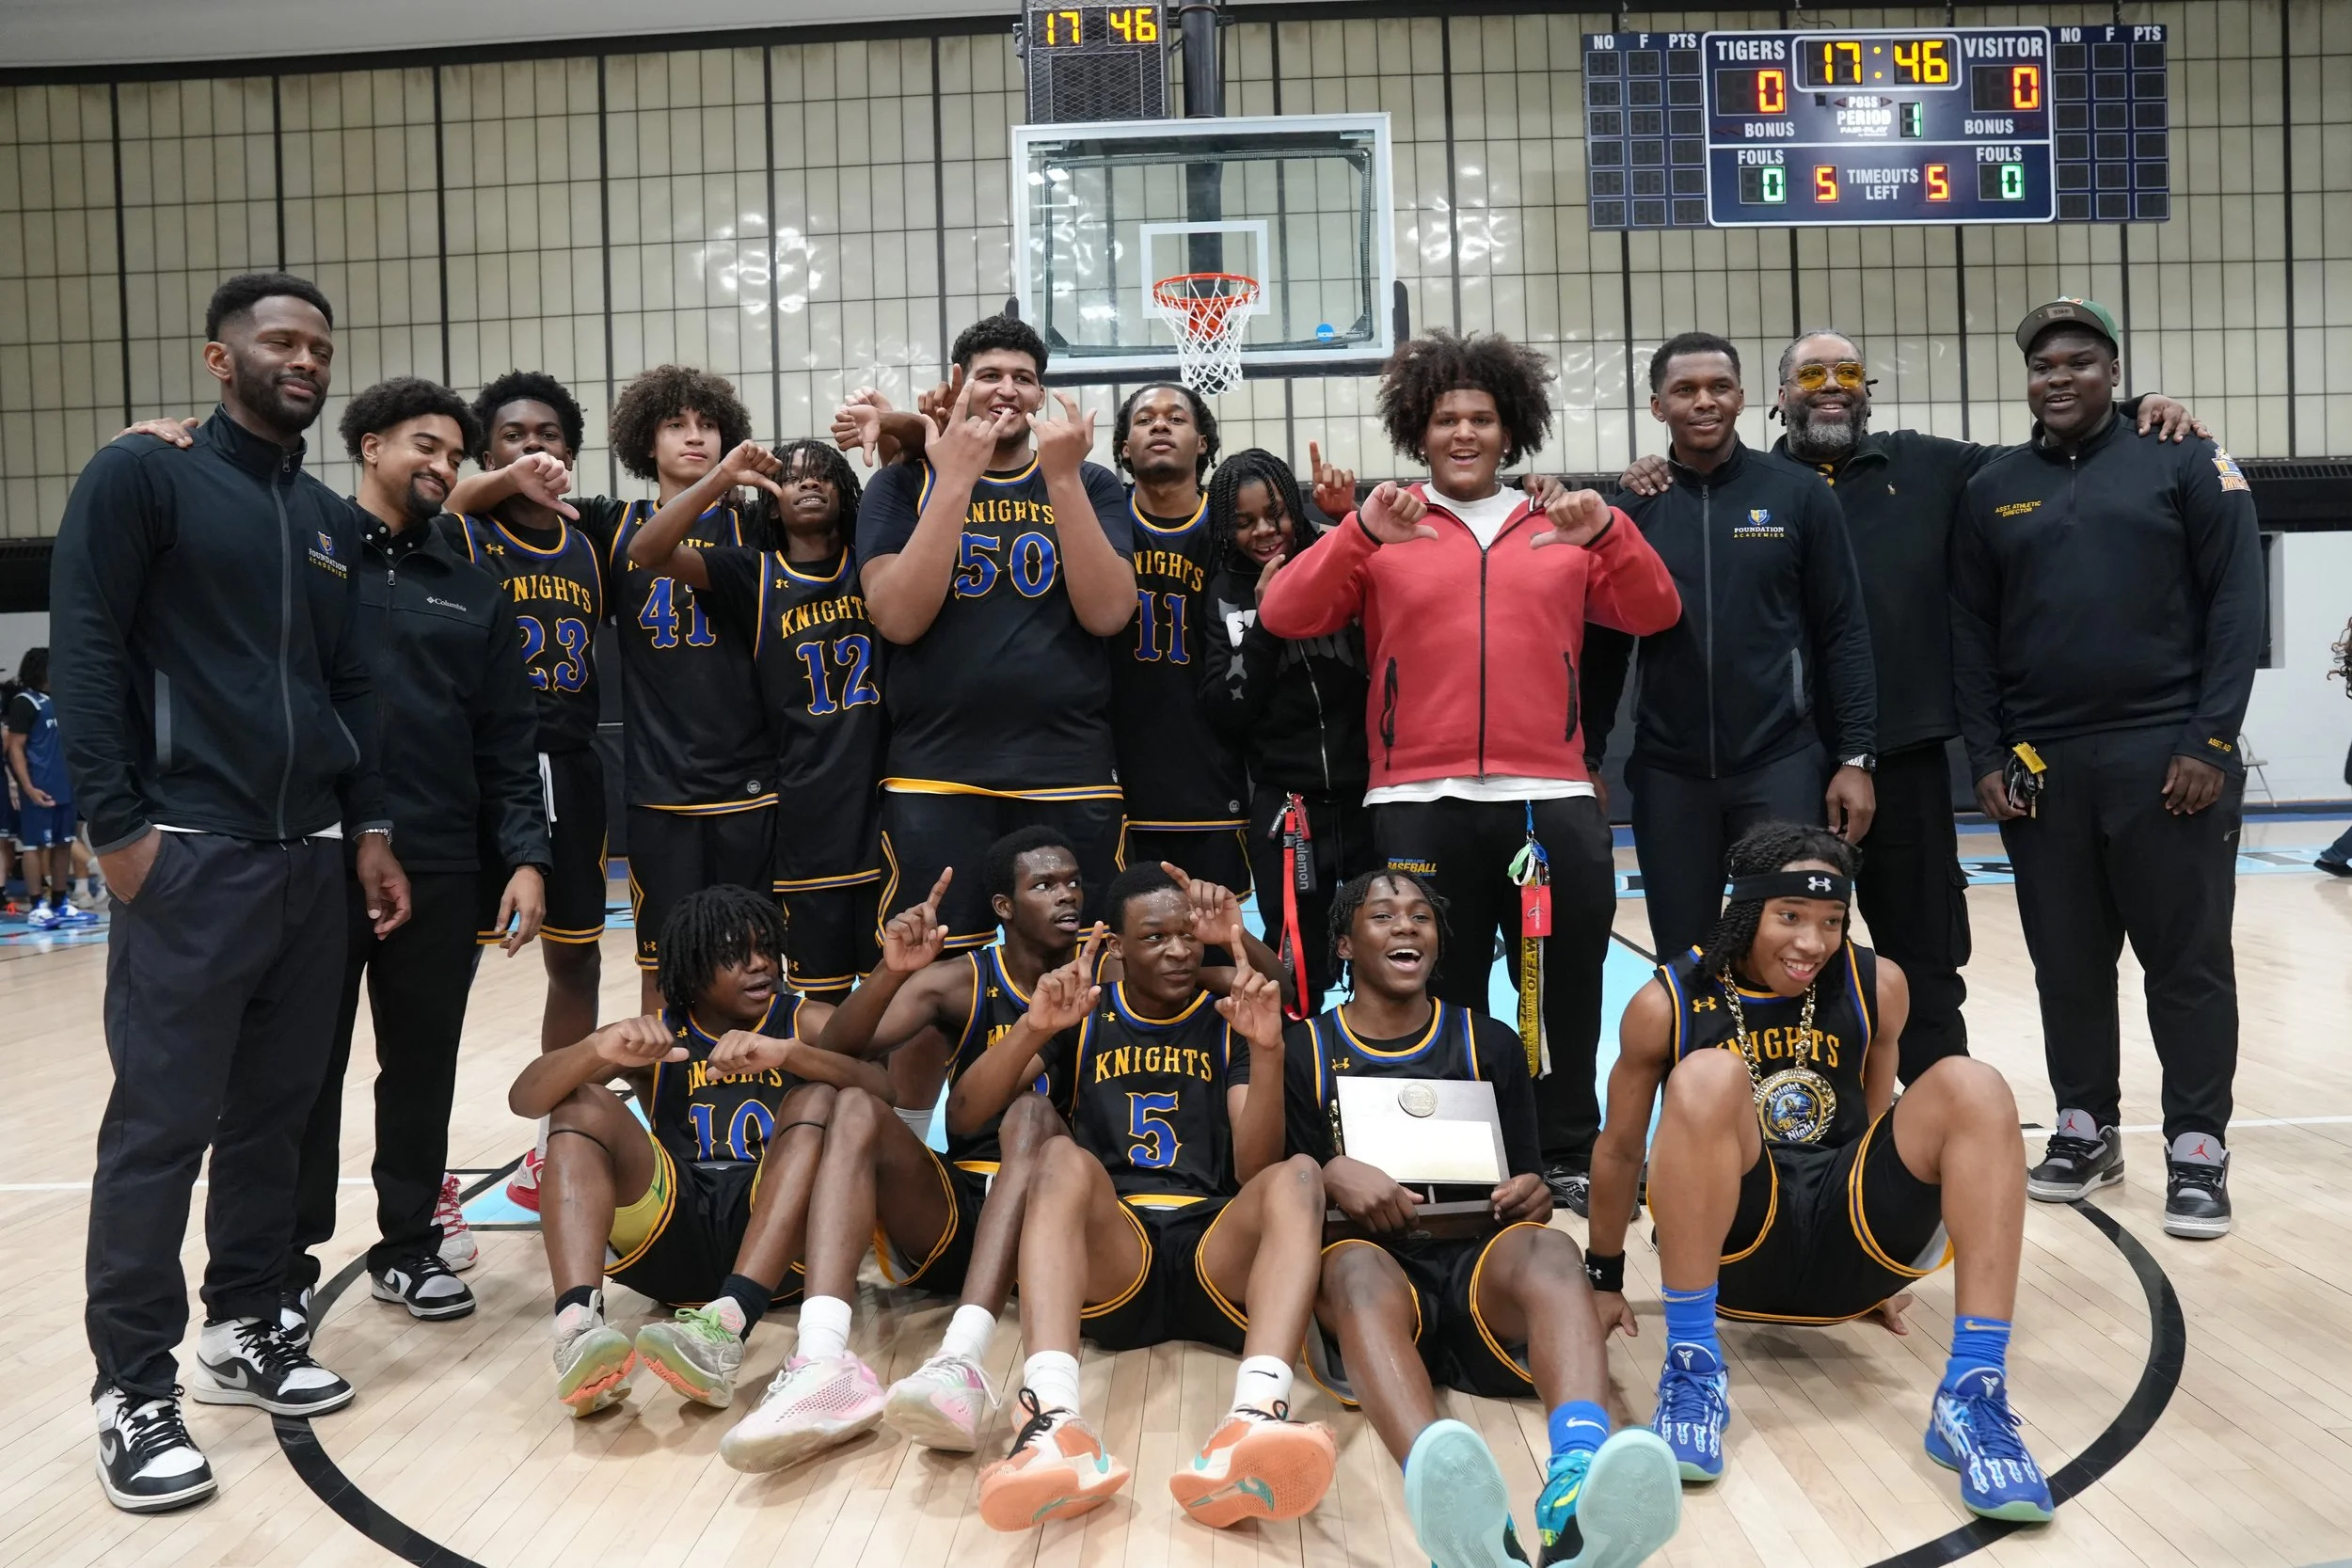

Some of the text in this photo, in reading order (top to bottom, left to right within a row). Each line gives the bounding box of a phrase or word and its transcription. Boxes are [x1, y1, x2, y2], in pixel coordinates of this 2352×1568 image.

[1046, 8, 1157, 45] 17 46
[1594, 33, 1696, 50] NO F PTS
[2060, 26, 2161, 42] NO F PTS
[1716, 40, 1786, 61] TIGERS
[1823, 41, 1948, 85] 17:46
[1963, 38, 2043, 57] VISITOR
[1757, 71, 1784, 112] 0
[1848, 96, 1879, 108] POSS
[2013, 67, 2039, 109] 0
[1744, 122, 1795, 137] BONUS
[1836, 109, 1892, 125] PERIOD
[1912, 103, 1921, 137] 1
[1964, 119, 2014, 135] BONUS
[1738, 150, 1784, 165] FOULS
[1977, 147, 2022, 162] FOULS
[1762, 168, 1784, 202] 0
[1816, 167, 1837, 200] 5
[1847, 168, 1919, 184] TIMEOUTS
[1866, 185, 1899, 199] LEFT
[1928, 166, 1948, 199] 5
[2001, 165, 2022, 198] 0
[964, 499, 1056, 525] NIGHTS
[2012, 500, 2042, 510] ATHLETIC
[309, 547, 347, 572] FOUNDATION
[955, 531, 1060, 600] 50
[1133, 549, 1204, 593] NIGHTS
[434, 597, 467, 611] Columbia
[500, 574, 592, 614] NIGHTS
[638, 577, 716, 649] 41
[781, 595, 875, 640] KNIGHT
[1135, 588, 1190, 665] 11
[516, 614, 590, 692] 23
[796, 633, 880, 716] 12
[1388, 862, 1438, 873] BASEBALL
[1095, 1046, 1213, 1082] KNIGHTS
[1768, 1082, 1802, 1105] Knight
[689, 1099, 775, 1162] 10
[1125, 1091, 1183, 1168] 5
[1787, 1119, 1816, 1141] Night
